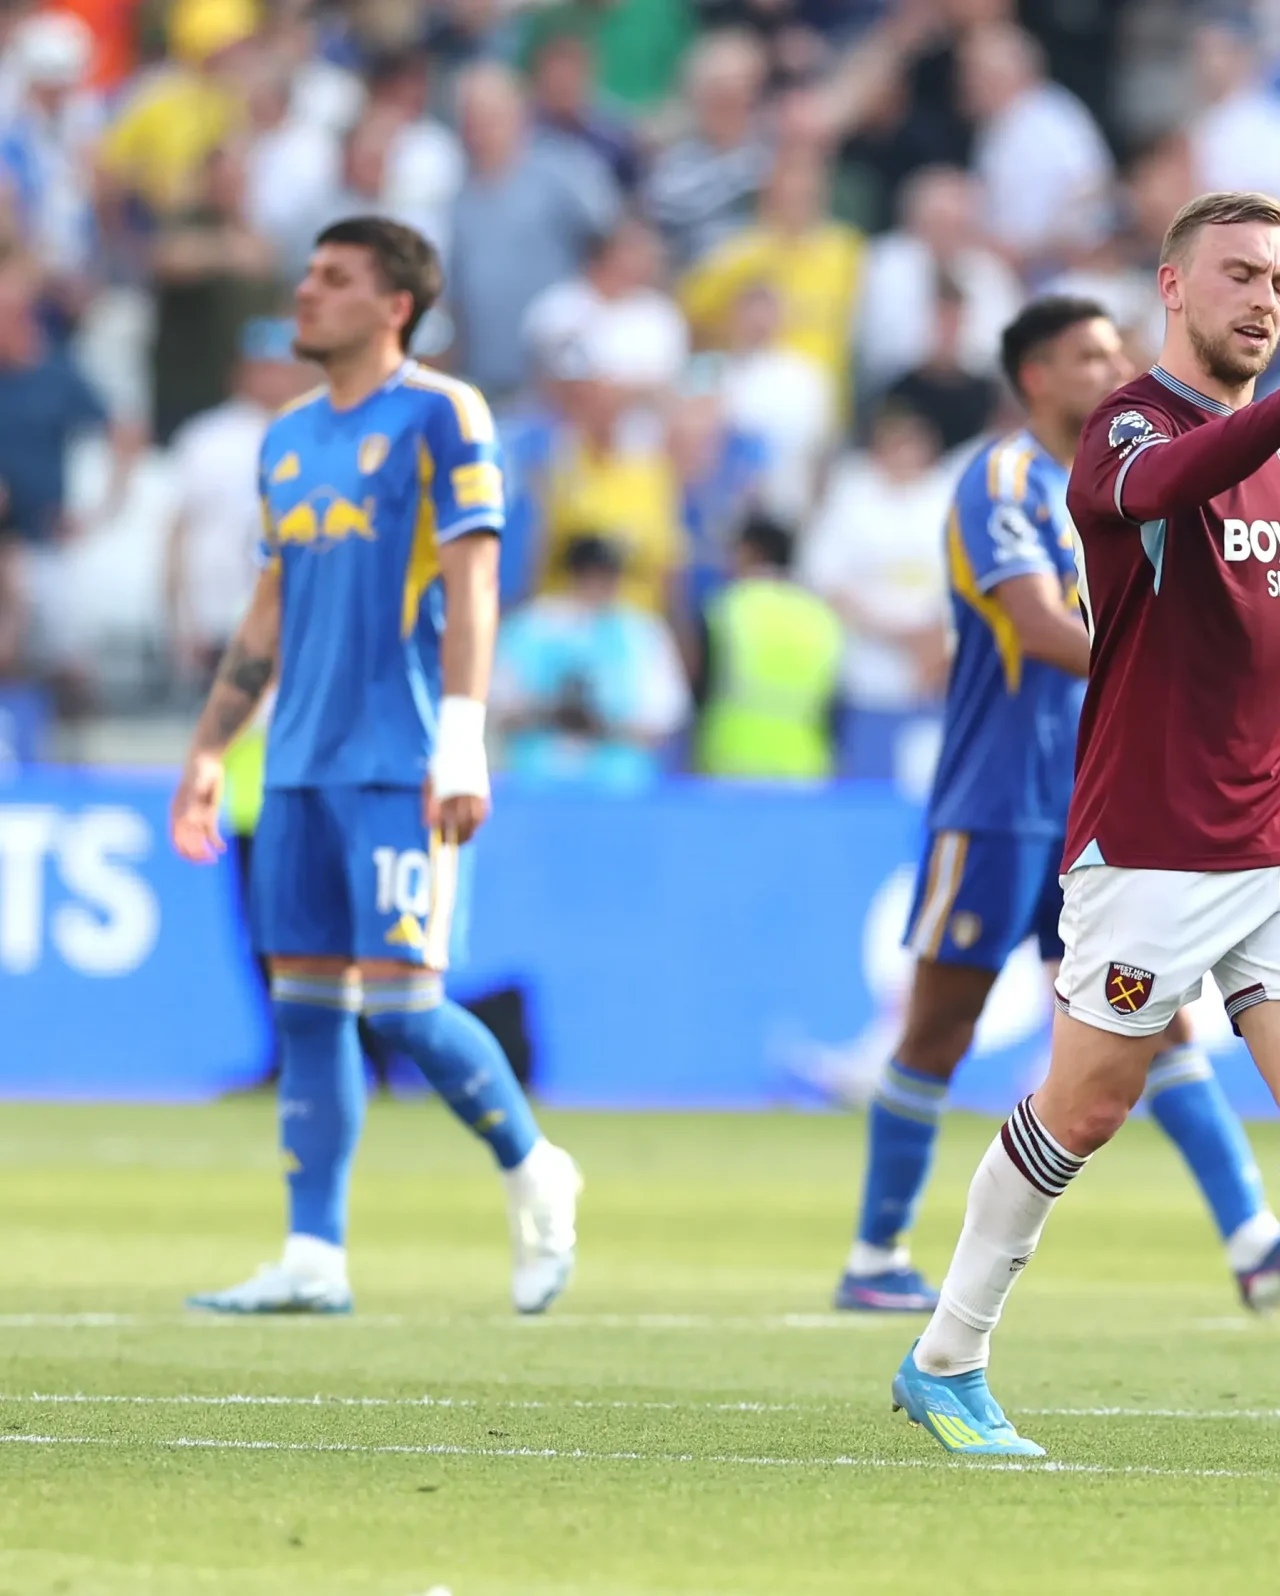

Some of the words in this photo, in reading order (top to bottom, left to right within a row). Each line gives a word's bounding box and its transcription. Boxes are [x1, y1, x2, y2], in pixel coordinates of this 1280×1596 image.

[373, 846, 431, 917] 10
[1114, 964, 1133, 973] WEST
[1134, 969, 1151, 979] HAM
[1120, 970, 1142, 980] UNITED
